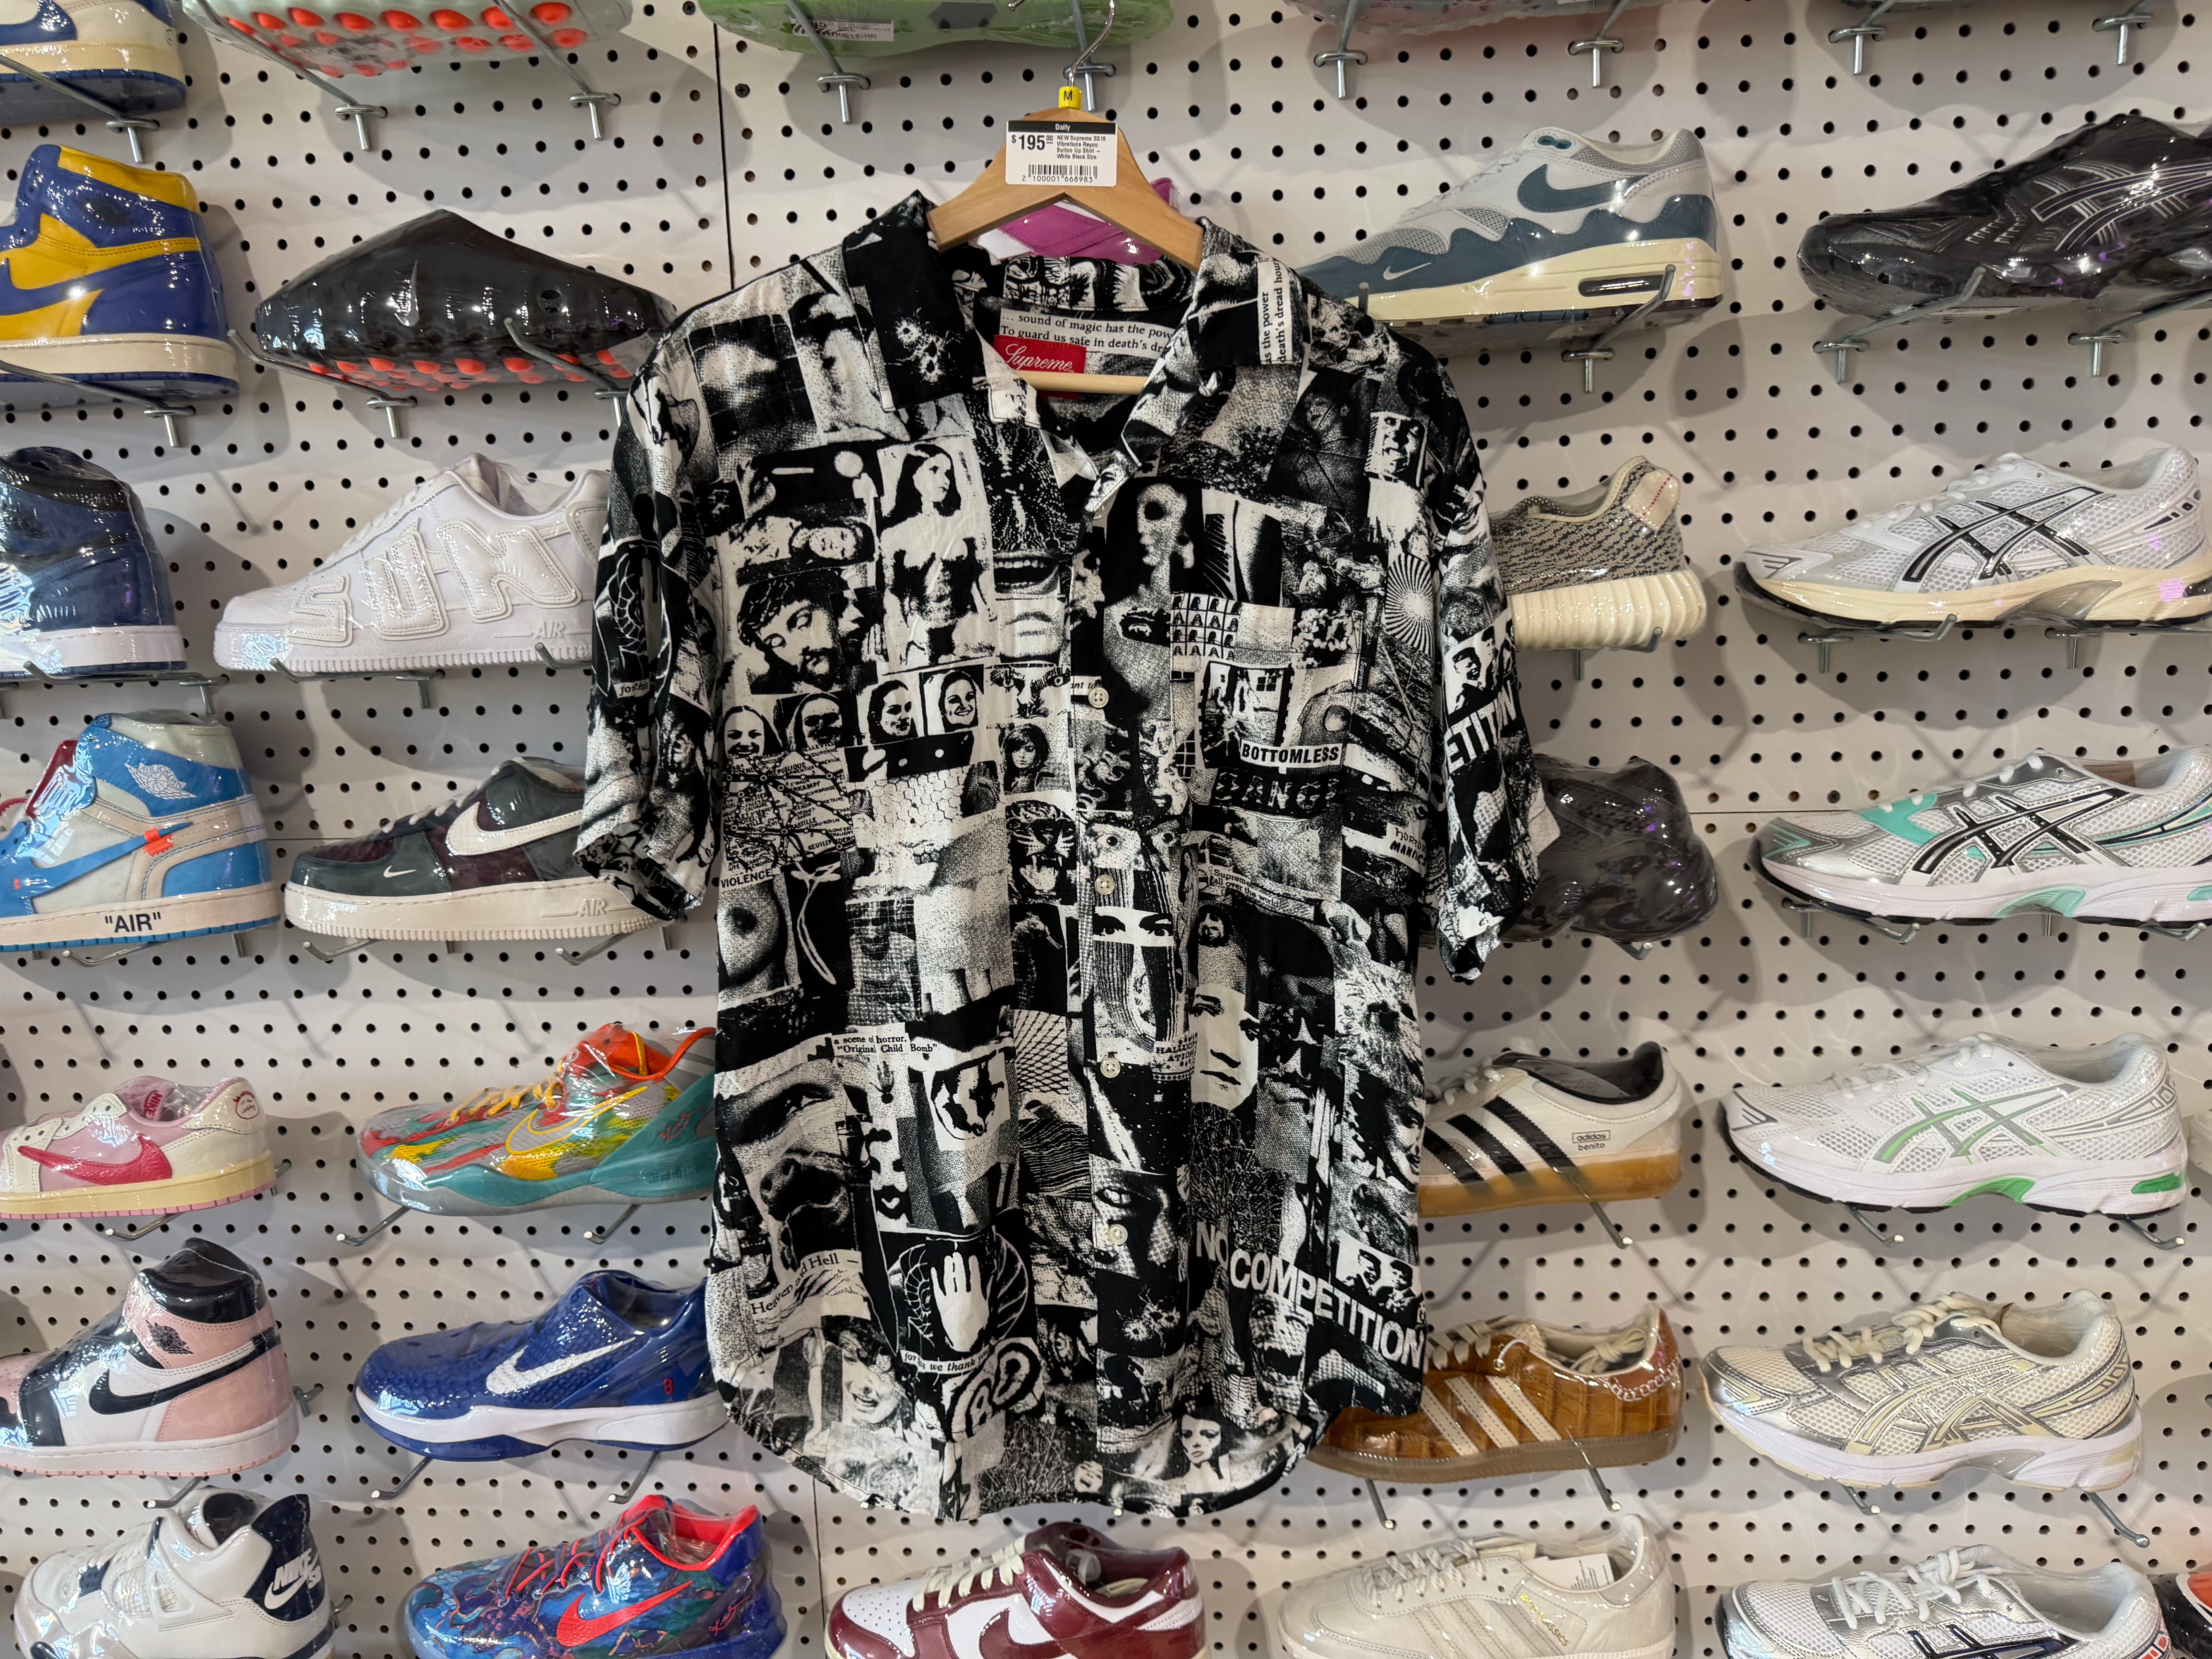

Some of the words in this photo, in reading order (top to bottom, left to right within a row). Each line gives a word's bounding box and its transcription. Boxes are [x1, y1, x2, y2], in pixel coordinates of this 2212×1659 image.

[1064, 90, 1073, 101] M
[1273, 262, 1282, 283] hour
[1262, 291, 1273, 327] power
[1274, 287, 1284, 319] dread
[1018, 314, 1051, 325] sound
[1055, 318, 1066, 327] of
[1070, 322, 1101, 334] magic
[1106, 323, 1123, 333] has
[1128, 324, 1145, 335] the
[1001, 326, 1015, 335] To
[1018, 330, 1049, 339] guard
[1070, 335, 1090, 346] safe
[1094, 338, 1105, 346] in
[1109, 339, 1147, 350] death's
[1262, 330, 1271, 349] the
[1275, 321, 1286, 363] death's
[1006, 344, 1072, 371] Supreme
[536, 620, 566, 641] AIR
[1357, 661, 1367, 690] Supreme
[1242, 743, 1339, 764] BOTTOMLESS
[721, 868, 773, 888] VIOLENCE
[1214, 869, 1251, 887] Supreme
[1225, 881, 1243, 891] over
[1244, 887, 1257, 898] the
[1259, 895, 1279, 908] world
[577, 898, 606, 917] AIR
[105, 912, 162, 934] "AIR"
[876, 1035, 907, 1044] horror.
[881, 1043, 903, 1053] Child
[1577, 1133, 1606, 1141] adidas
[1578, 1142, 1605, 1151] benito
[1197, 1221, 1228, 1271] NO
[750, 1284, 793, 1314] Heaven
[808, 1252, 840, 1269] Hell
[1230, 1248, 1426, 1369] COMPETITION
[930, 1362, 943, 1371] we
[947, 1358, 976, 1371] thank
[664, 1377, 674, 1394] 8
[273, 1548, 313, 1591] NIKE
